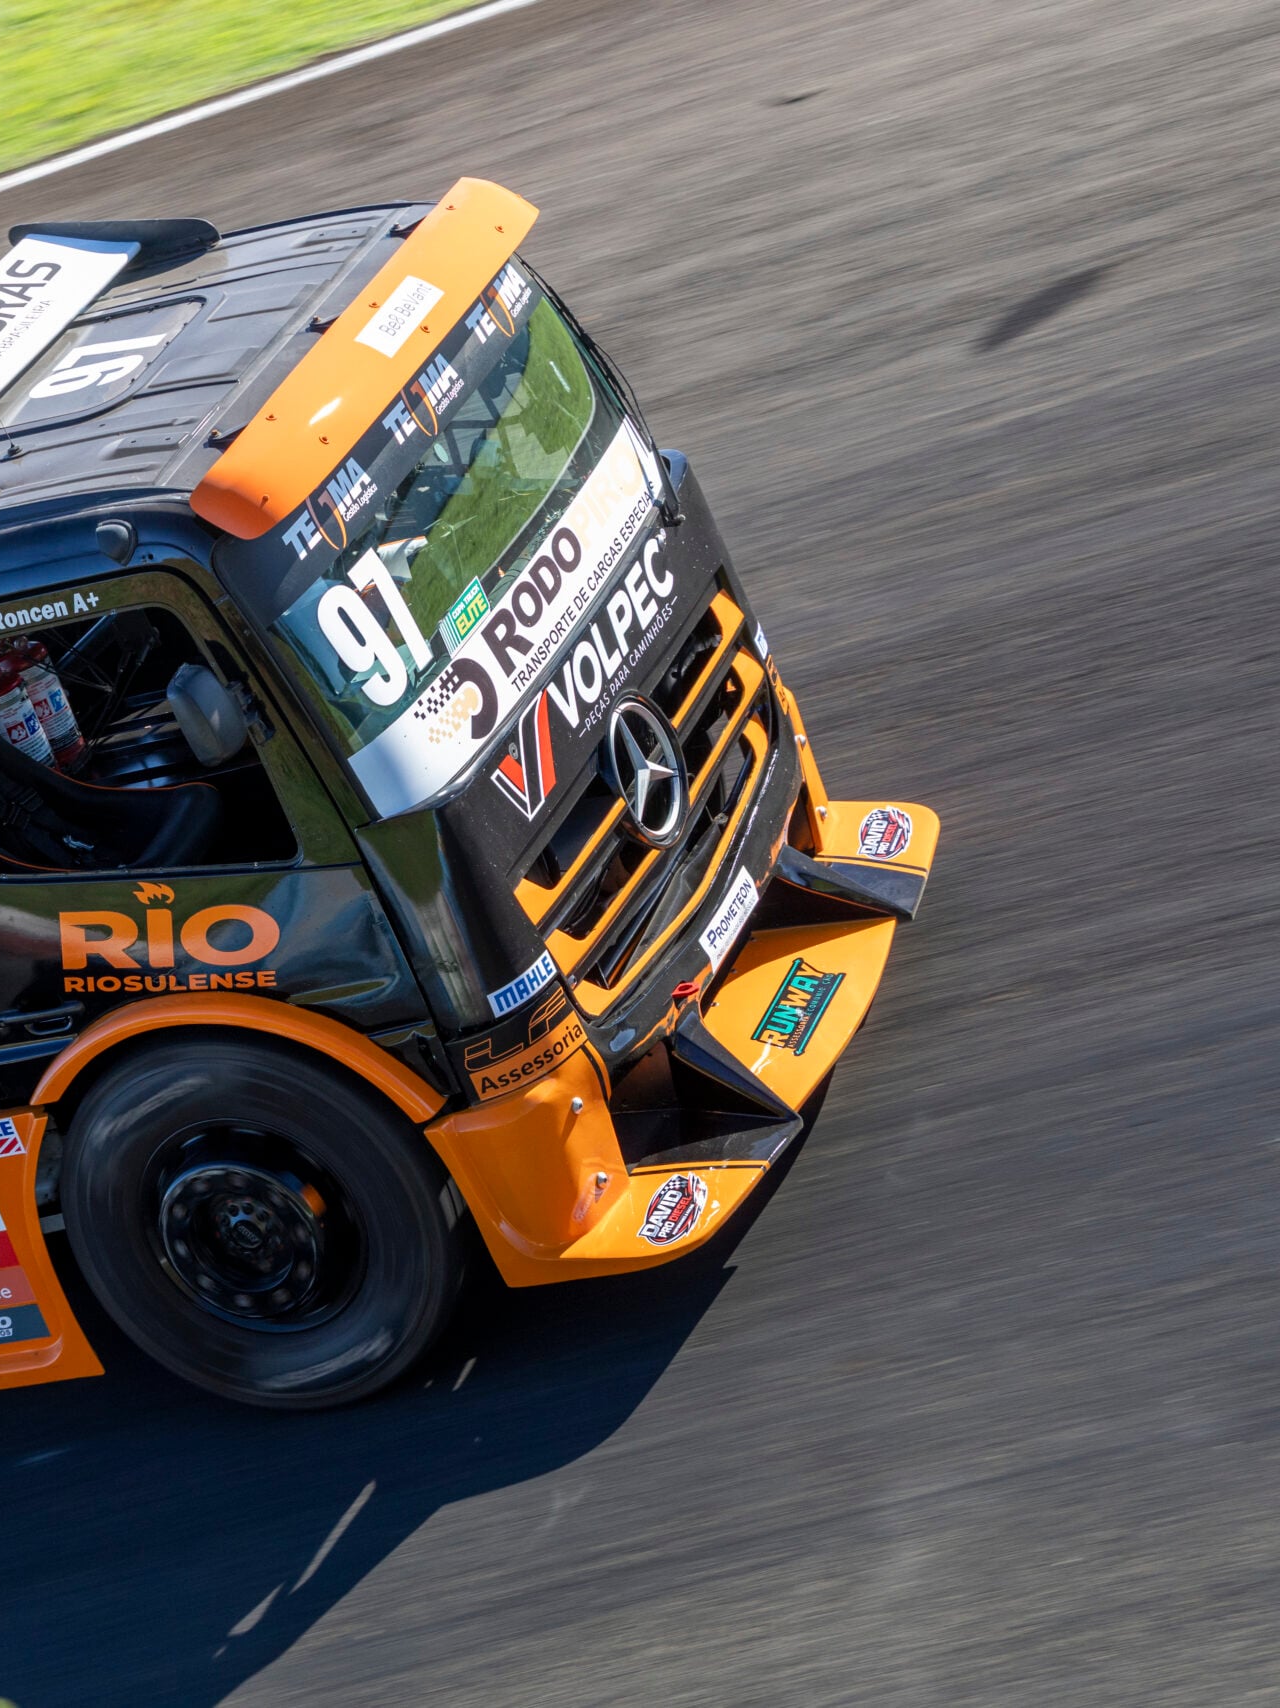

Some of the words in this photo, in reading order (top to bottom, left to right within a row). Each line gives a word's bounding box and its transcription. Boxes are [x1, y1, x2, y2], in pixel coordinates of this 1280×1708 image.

[28, 333, 167, 399] 97
[73, 591, 100, 614] A+
[455, 591, 488, 636] ELITE
[511, 606, 577, 692] TRANSPORTE
[573, 587, 590, 611] DE
[586, 537, 623, 592] CARGAS
[619, 481, 654, 541] ESPECIAS
[317, 547, 434, 706] 97
[546, 538, 674, 729] VOLPEC
[584, 692, 610, 731] PEÇAS
[609, 665, 630, 696] PARA
[629, 603, 673, 667] CAMINHÕES
[859, 820, 889, 855] DAVID
[59, 904, 281, 970] RIO
[706, 878, 752, 949] PROMETEON
[64, 970, 278, 993] RIOSULENSE
[493, 956, 553, 1013] MAHLE
[759, 961, 824, 1047] RUNWAY
[480, 1023, 583, 1095] Assessoria
[639, 1189, 683, 1238] DAVID
[657, 1220, 675, 1238] PRO
[668, 1195, 693, 1222] DIESEL
